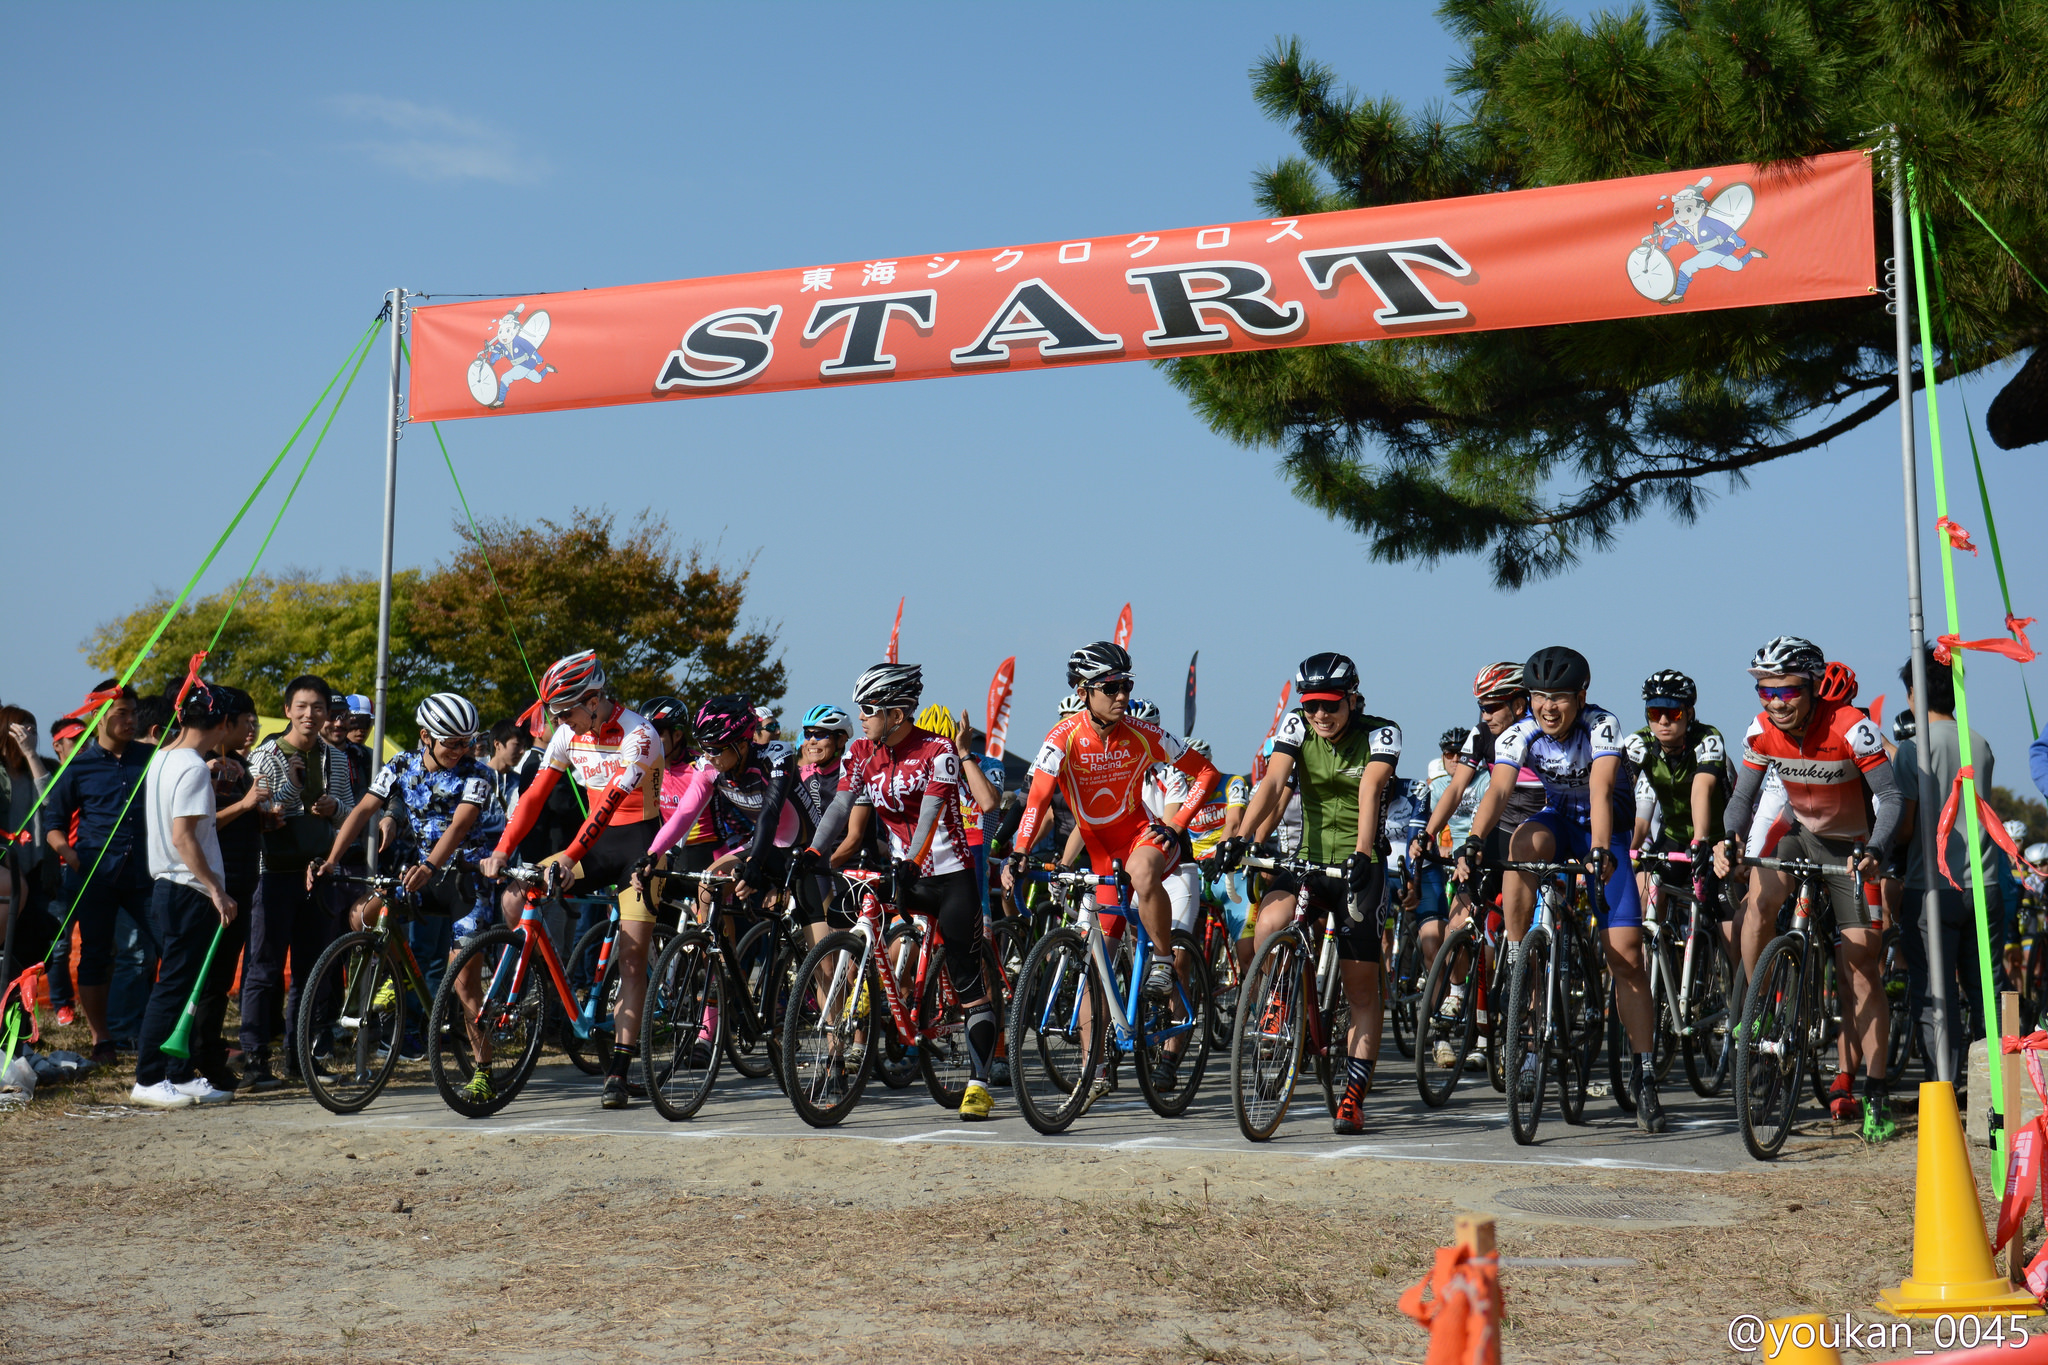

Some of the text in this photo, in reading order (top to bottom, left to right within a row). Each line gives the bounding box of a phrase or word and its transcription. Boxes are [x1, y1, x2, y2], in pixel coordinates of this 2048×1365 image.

[800, 219, 1303, 294] 東海シクロクロス
[655, 237, 1473, 392] START
[1047, 719, 1076, 744] STRADA
[1125, 716, 1164, 736] STRADA
[1283, 717, 1299, 734] 8
[1601, 725, 1614, 743] 4
[1857, 724, 1875, 746] 3
[1379, 728, 1393, 746] 8
[1502, 734, 1518, 747] 4
[945, 756, 956, 776] 6
[1080, 748, 1131, 765] STRADA
[1090, 759, 1122, 772] Racing
[582, 759, 621, 780] Red Mill
[1769, 758, 1846, 784] Marukiya
[631, 772, 643, 789] 1
[1186, 788, 1206, 810] Racing
[578, 788, 621, 849] FOCUS
[1021, 807, 1037, 838] STRADA
[2013, 1131, 2033, 1177] IRC
[2006, 1175, 2020, 1197] TIRE
